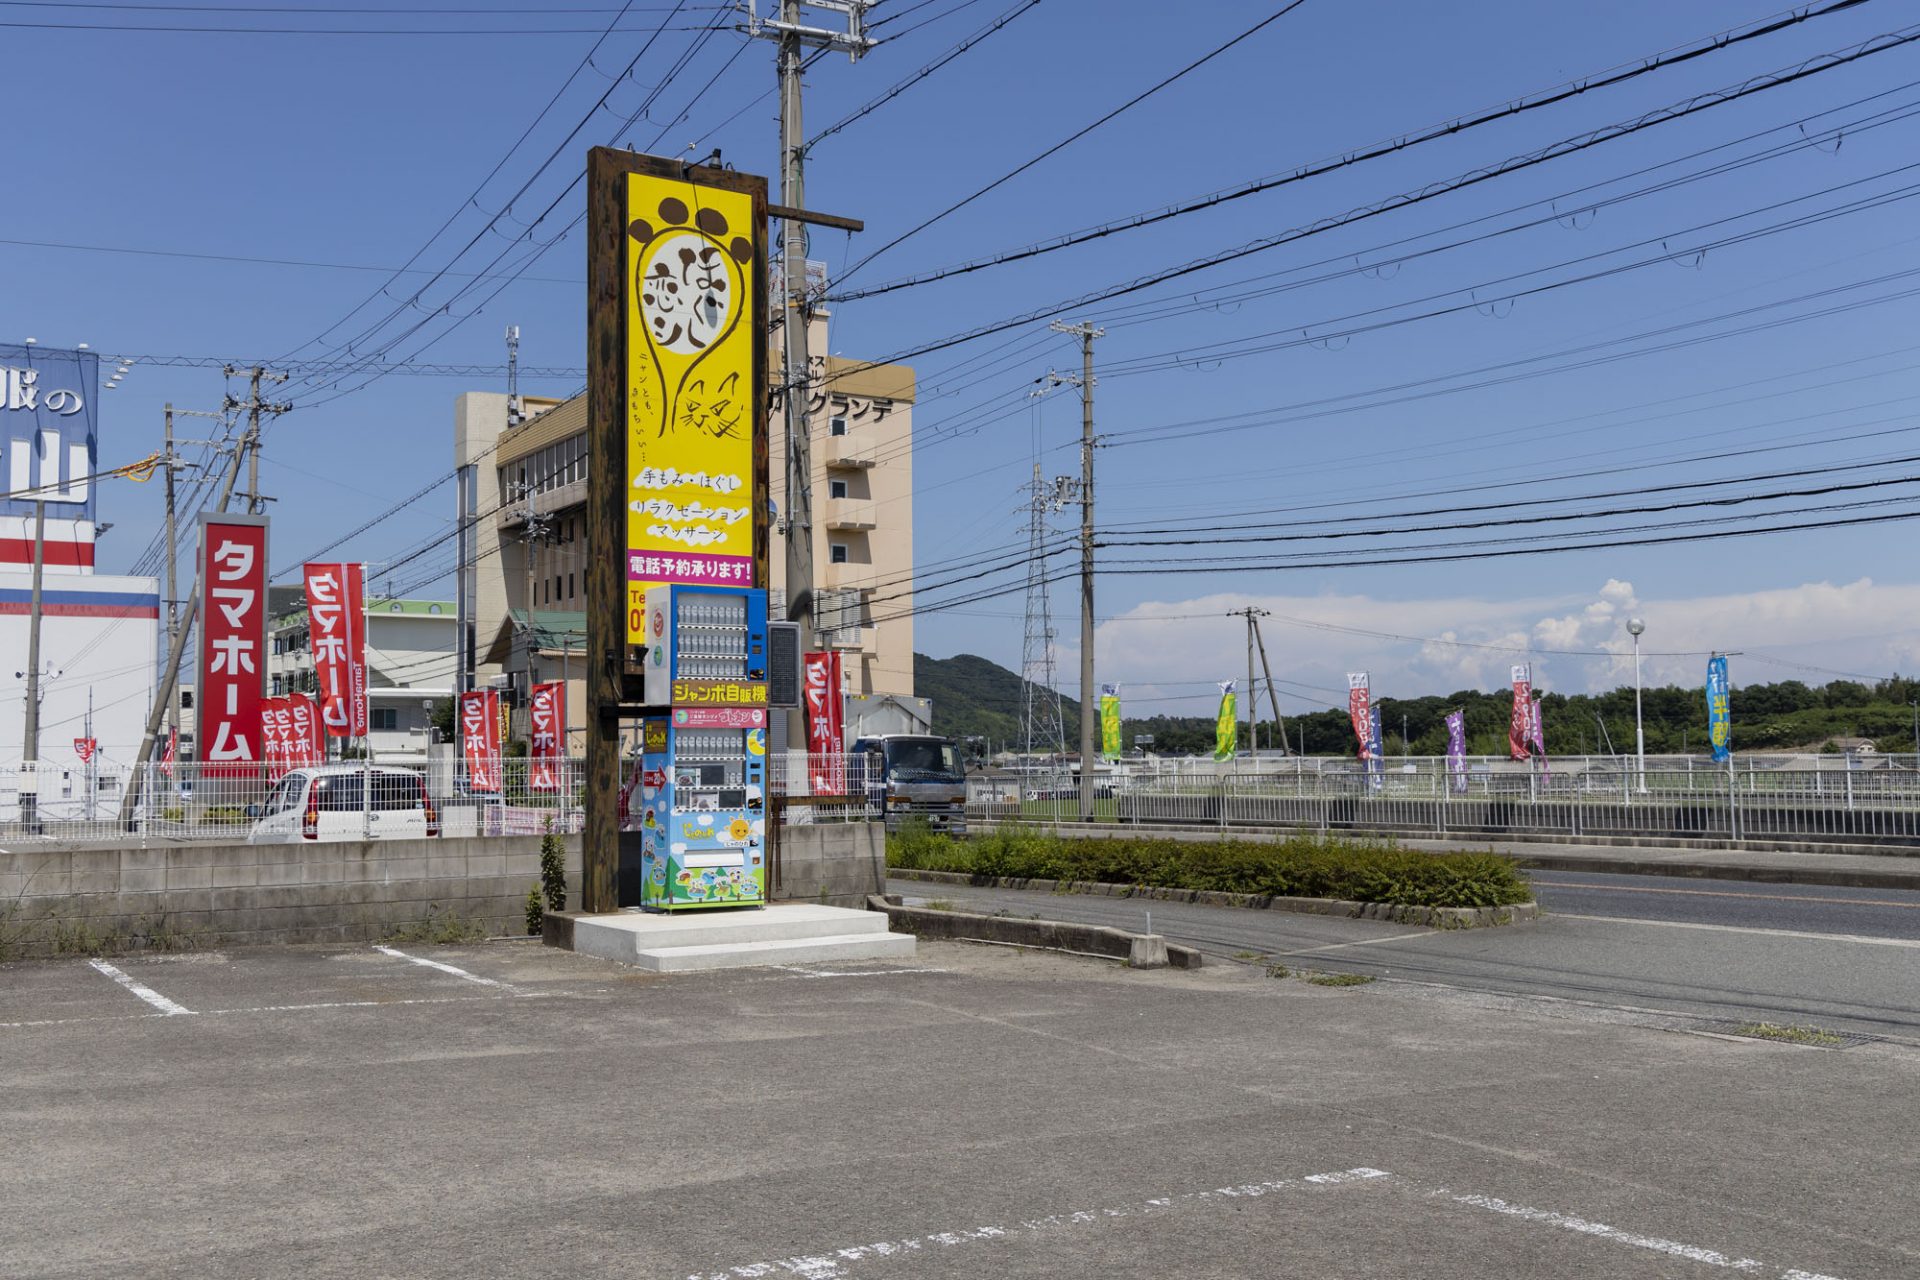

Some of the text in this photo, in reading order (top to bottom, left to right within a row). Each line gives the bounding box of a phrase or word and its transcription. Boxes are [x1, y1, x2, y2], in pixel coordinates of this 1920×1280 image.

[643, 469, 737, 491] 手もみ・ほぐし
[636, 501, 744, 520] リラクゼーション
[656, 525, 724, 540] マッサージ
[210, 540, 255, 761] タマホーム
[675, 684, 767, 703] ジャンボ自販機
